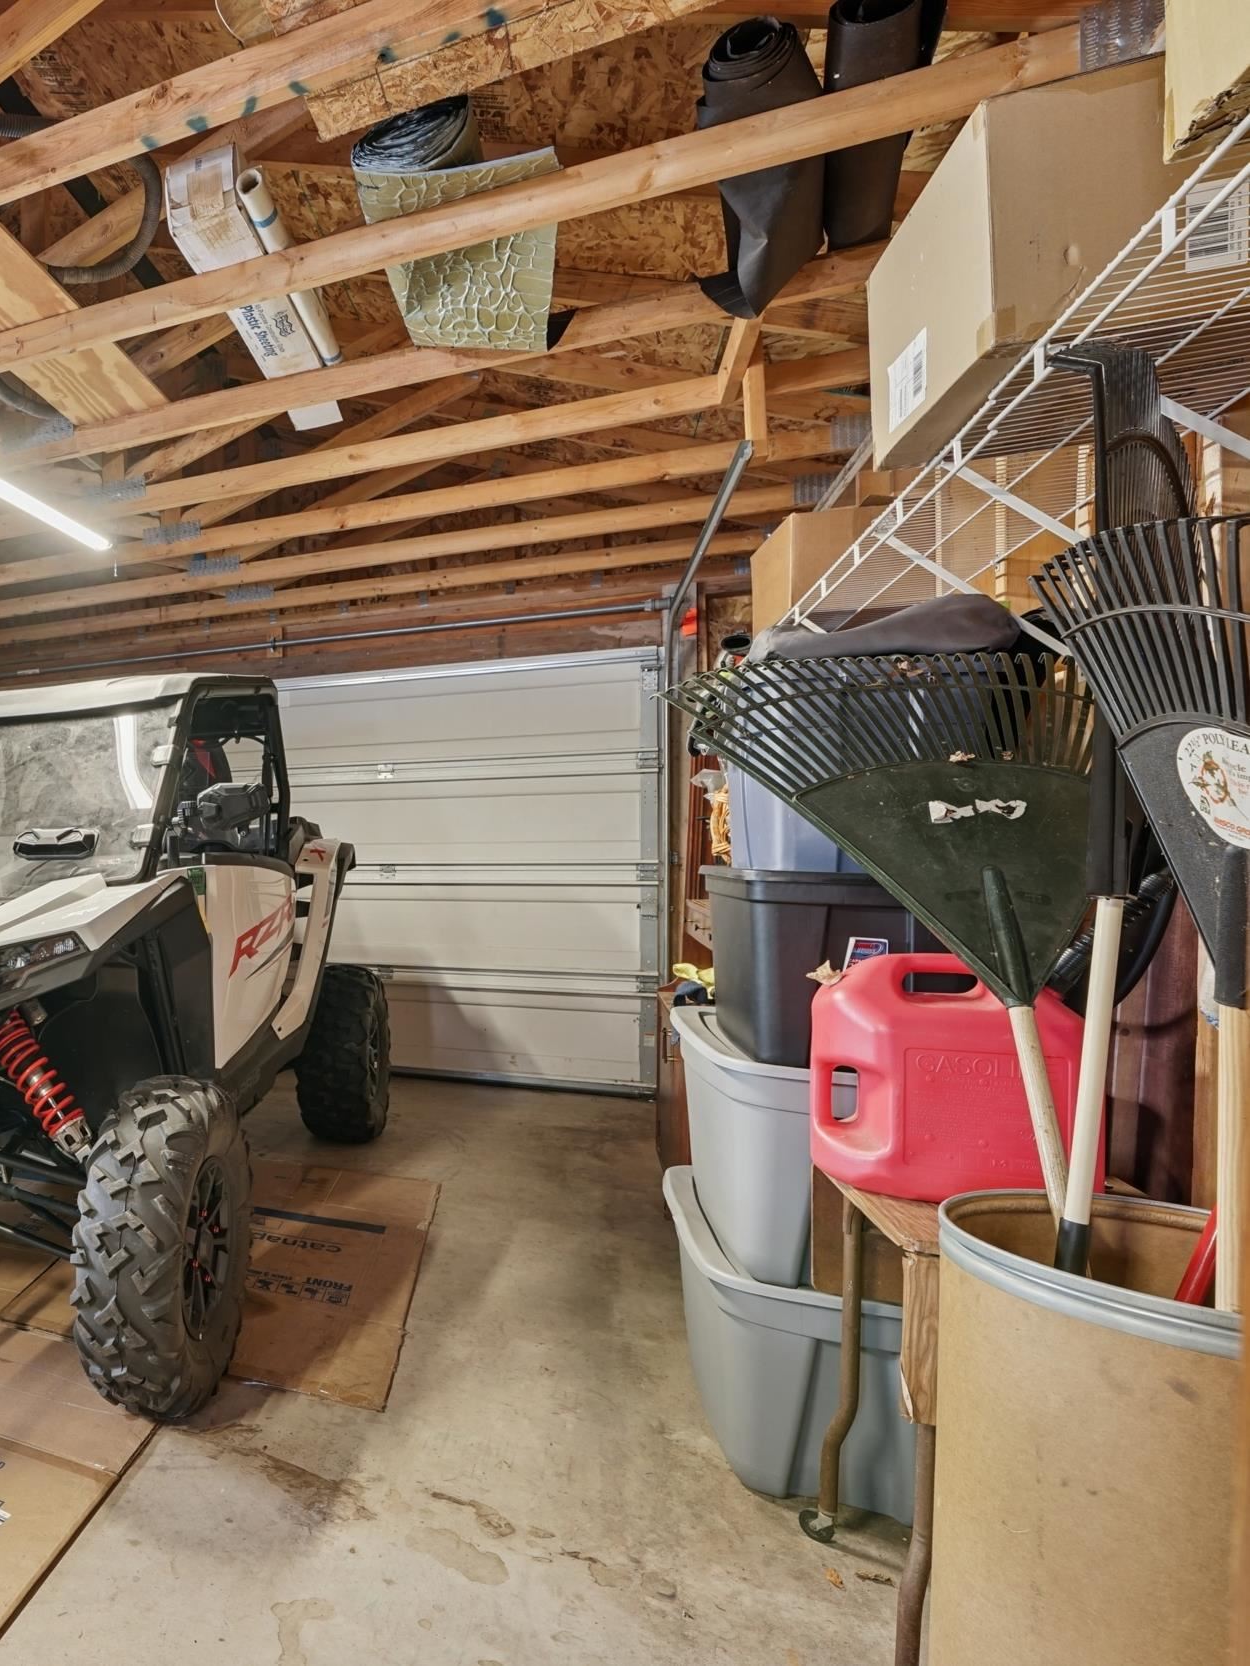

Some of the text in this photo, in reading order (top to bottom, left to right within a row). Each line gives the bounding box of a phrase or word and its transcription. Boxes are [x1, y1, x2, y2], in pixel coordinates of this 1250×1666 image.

[239, 305, 278, 357] Plastic Sheeting
[306, 1277, 353, 1291] FRONT
